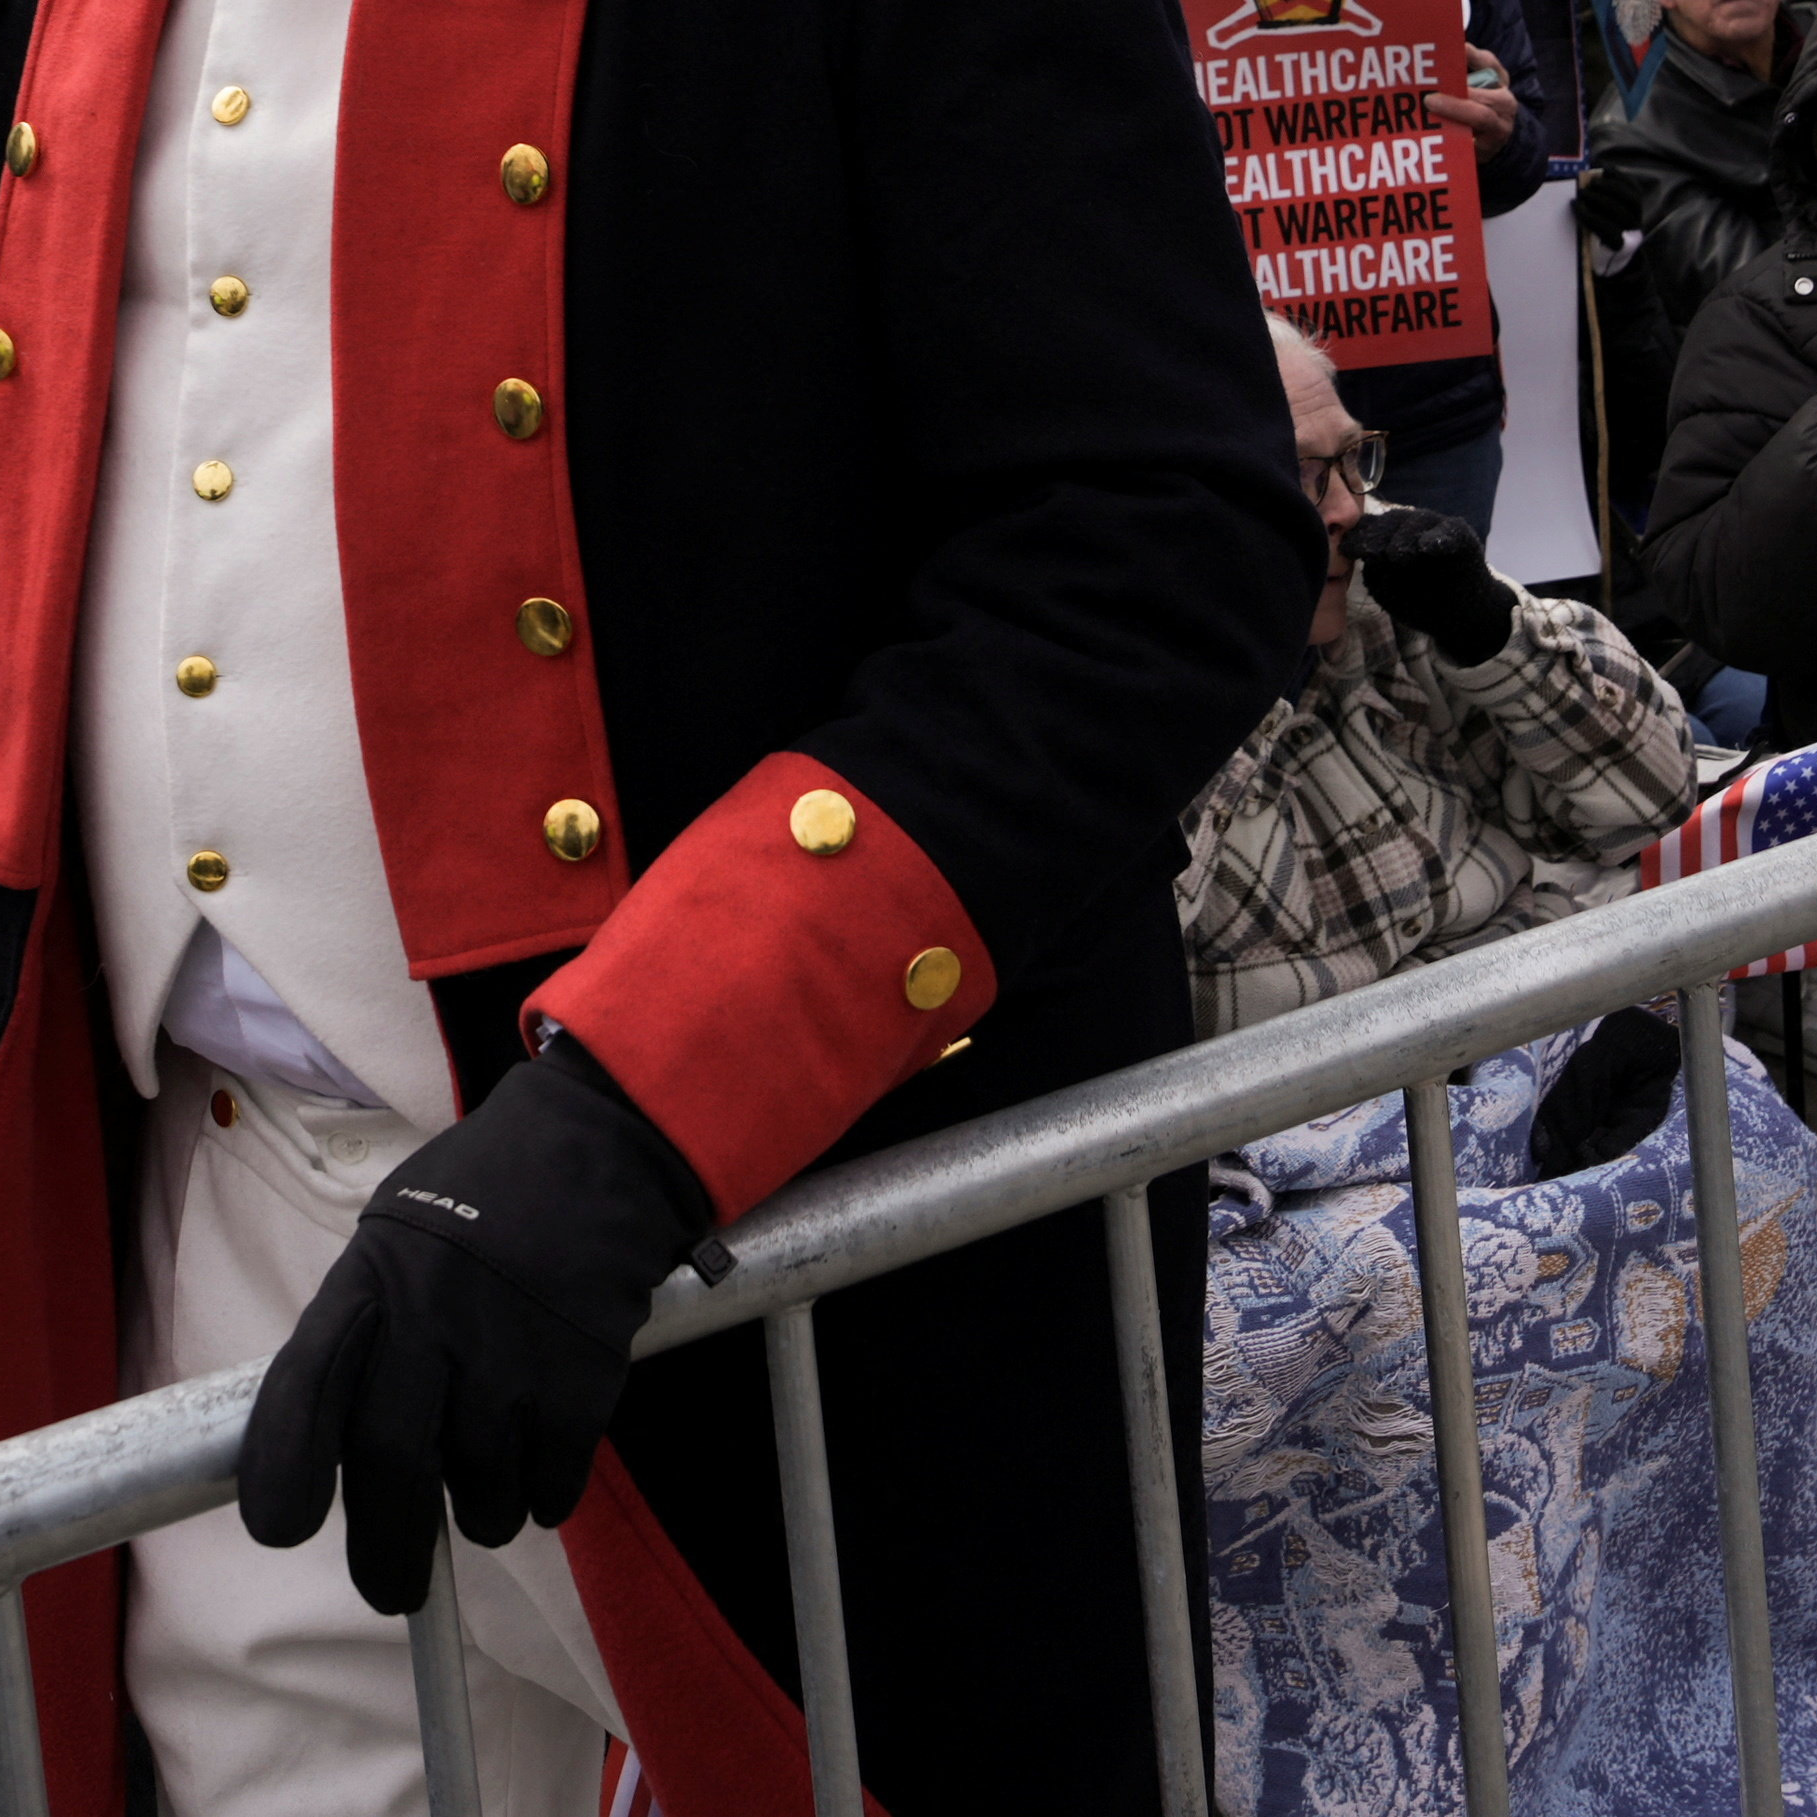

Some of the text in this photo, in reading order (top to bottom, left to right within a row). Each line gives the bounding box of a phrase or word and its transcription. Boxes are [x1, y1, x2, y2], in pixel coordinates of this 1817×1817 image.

[1265, 90, 1442, 147] WARFARE
[1274, 188, 1452, 249] WARFARE
[396, 1186, 480, 1221] HEAD
